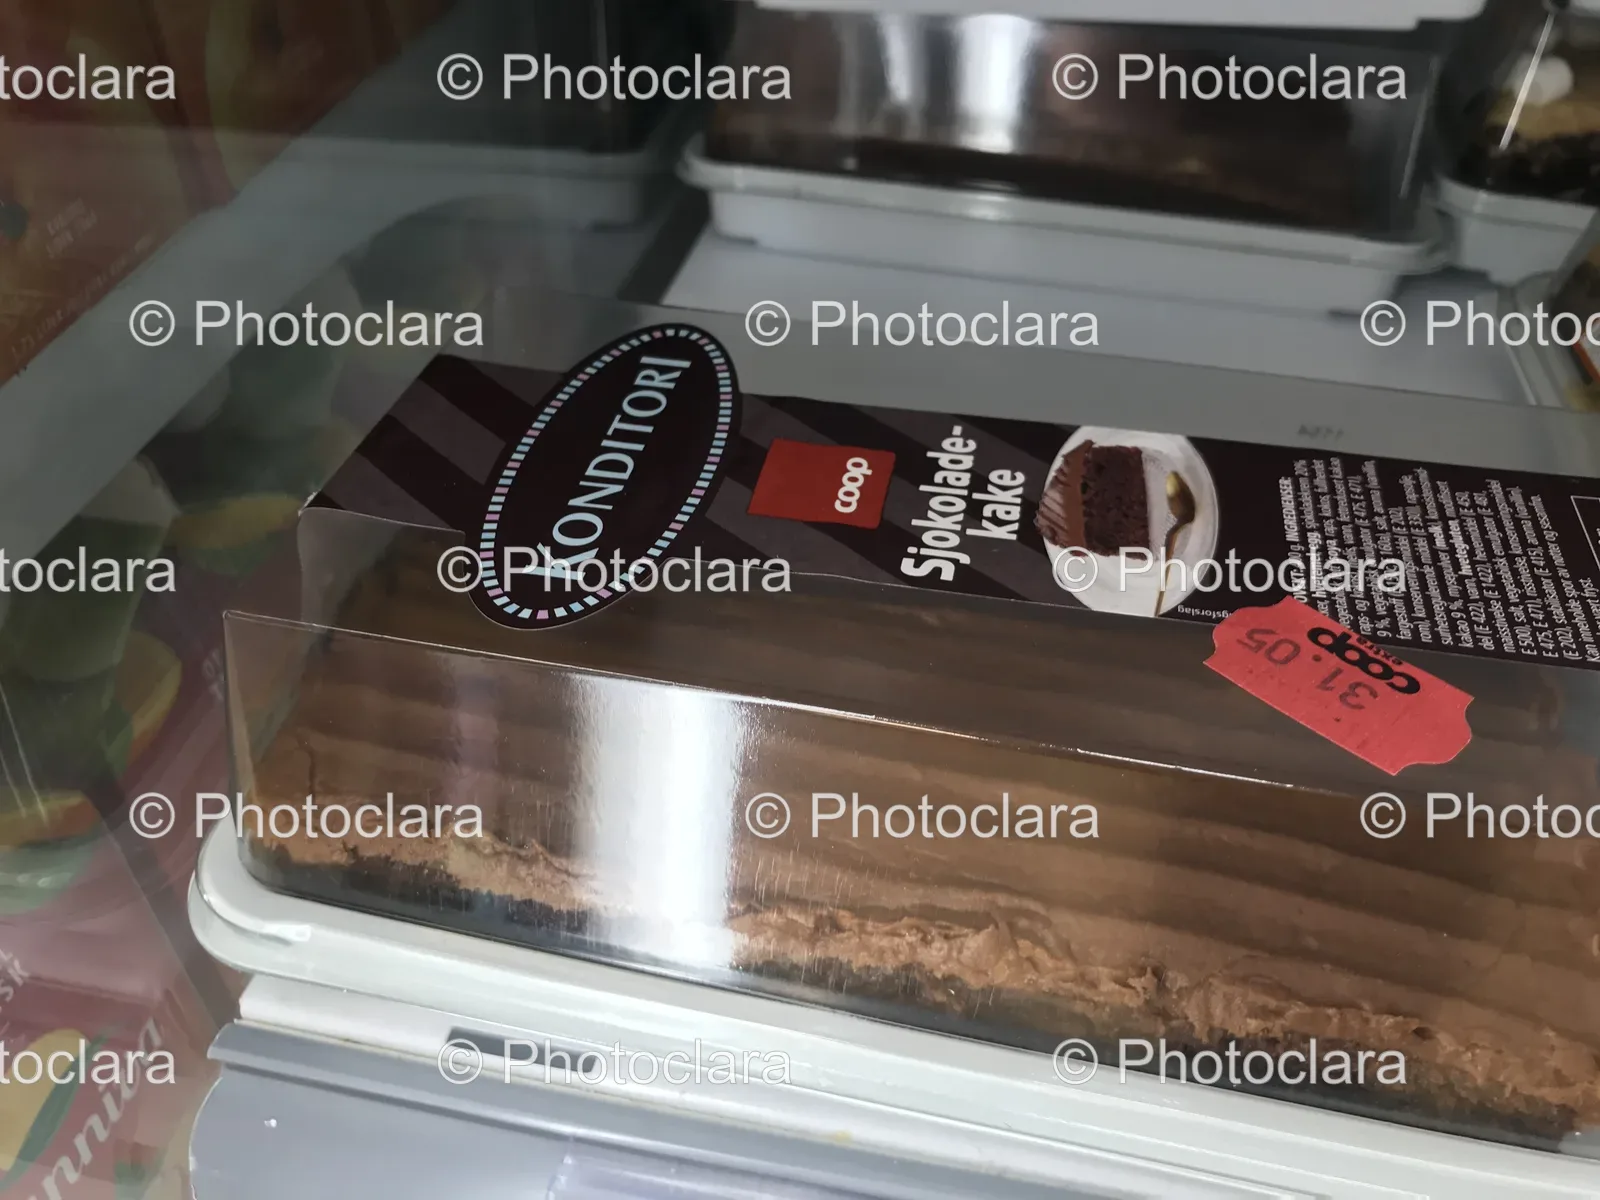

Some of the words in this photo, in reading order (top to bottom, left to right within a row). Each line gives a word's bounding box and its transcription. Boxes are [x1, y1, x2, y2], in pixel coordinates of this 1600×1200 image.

[522, 356, 692, 581] KONDITORI
[1293, 458, 1308, 476] 20%
[1327, 455, 1343, 478] kakao
[834, 457, 872, 513] coop
[900, 425, 977, 581] Sjokolade-
[966, 469, 1025, 540] kake
[1278, 475, 1299, 542] INGREDIENSER:
[1296, 476, 1320, 529] sjokoladekrem
[1369, 489, 1385, 514] aroma
[1487, 478, 1529, 555] konserveringsmiddel
[1341, 522, 1357, 545] vann,
[1462, 516, 1488, 561] hevemiddel
[1480, 515, 1510, 556] emulgator
[1520, 519, 1540, 545] aroma
[1542, 529, 1561, 542] og
[1413, 536, 1433, 564] middel
[1445, 517, 1479, 576] hvetegluten,
[1394, 534, 1431, 618] konserveringsmiddel
[1435, 550, 1465, 598] mysepulver
[1492, 555, 1525, 604] vegetabilsk
[1535, 566, 1553, 577] (E
[1556, 566, 1571, 578] av
[1364, 568, 1392, 616] vegetabilsk
[1464, 576, 1483, 600] vann,
[1484, 588, 1503, 599] (E
[1538, 576, 1568, 624] stabilisator
[1561, 578, 1583, 599] spor
[1177, 605, 1229, 618] gsforslag
[1354, 598, 1372, 611] og
[1389, 596, 1417, 640] fargestoff
[1419, 563, 1458, 645] surhetsregulerende
[1507, 603, 1529, 623] salt,
[1356, 612, 1376, 635] raps-
[1413, 617, 1435, 643] rom),
[1453, 618, 1474, 647] kakao
[1474, 623, 1493, 635] (E
[1487, 598, 1516, 652] maisstivelse
[1565, 598, 1595, 643] inneholde
[1356, 636, 1403, 666] extra
[1477, 634, 1495, 650] del
[1535, 628, 1559, 650] 475,
[1581, 642, 1600, 662] Kan
[1307, 627, 1421, 694] coop
[1563, 649, 1583, 660] (E
